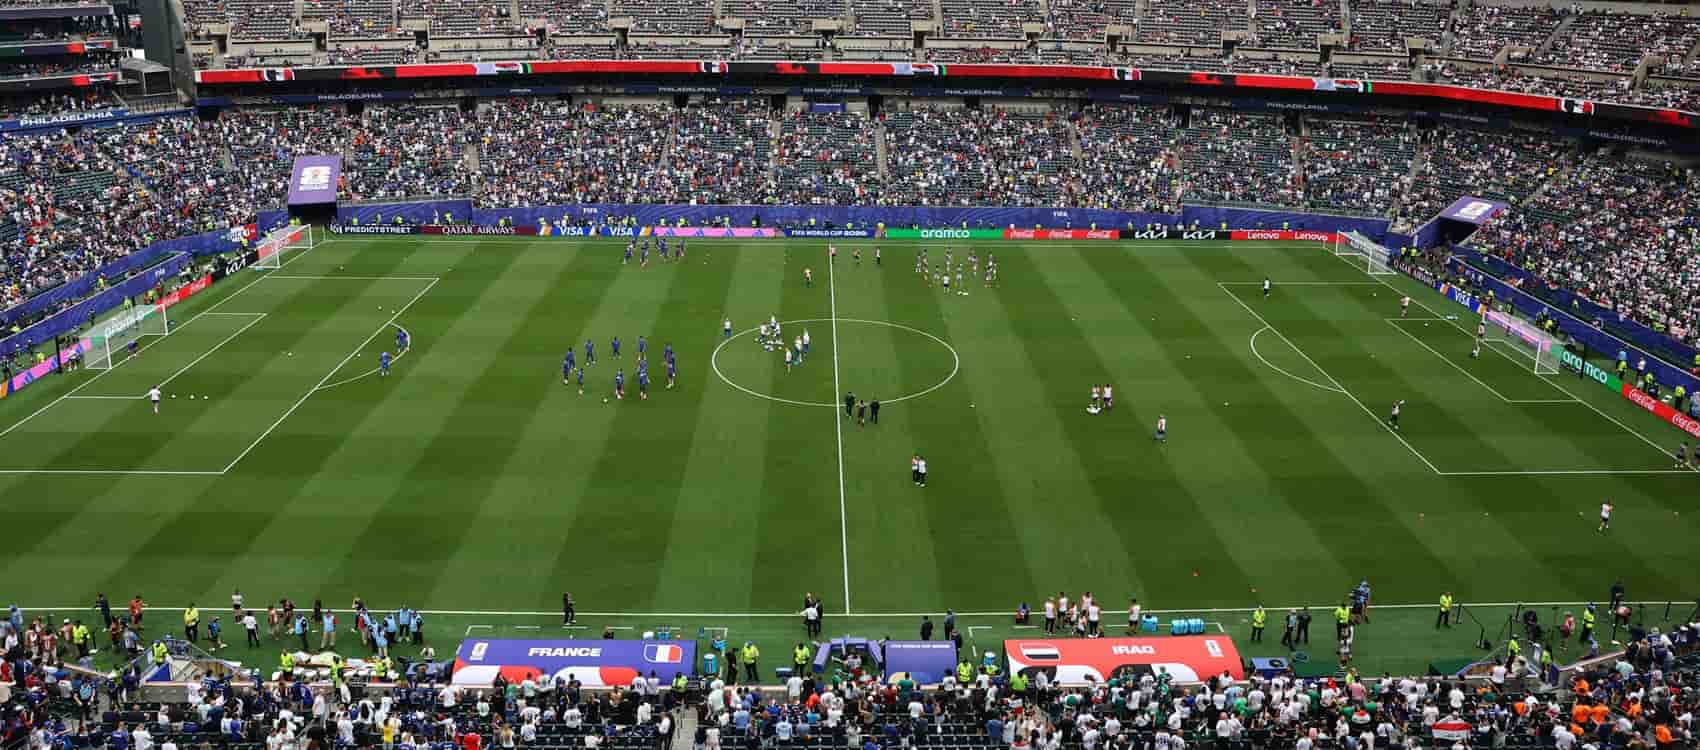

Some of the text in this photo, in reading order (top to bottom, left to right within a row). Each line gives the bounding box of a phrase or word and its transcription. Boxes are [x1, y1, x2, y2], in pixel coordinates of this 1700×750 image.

[19, 111, 113, 126] PHILADELPHIA
[442, 226, 515, 235] QATAR AIRWAYS
[560, 226, 583, 235] VISA
[610, 226, 633, 235] VISA
[921, 229, 970, 238] aramco
[1247, 231, 1280, 239] Lenovo
[1294, 231, 1328, 241] Lenovo
[1455, 289, 1470, 309] VISA
[1562, 351, 1608, 384] aramco
[528, 647, 602, 657] FRANCE
[1112, 645, 1156, 655] IRAQ
